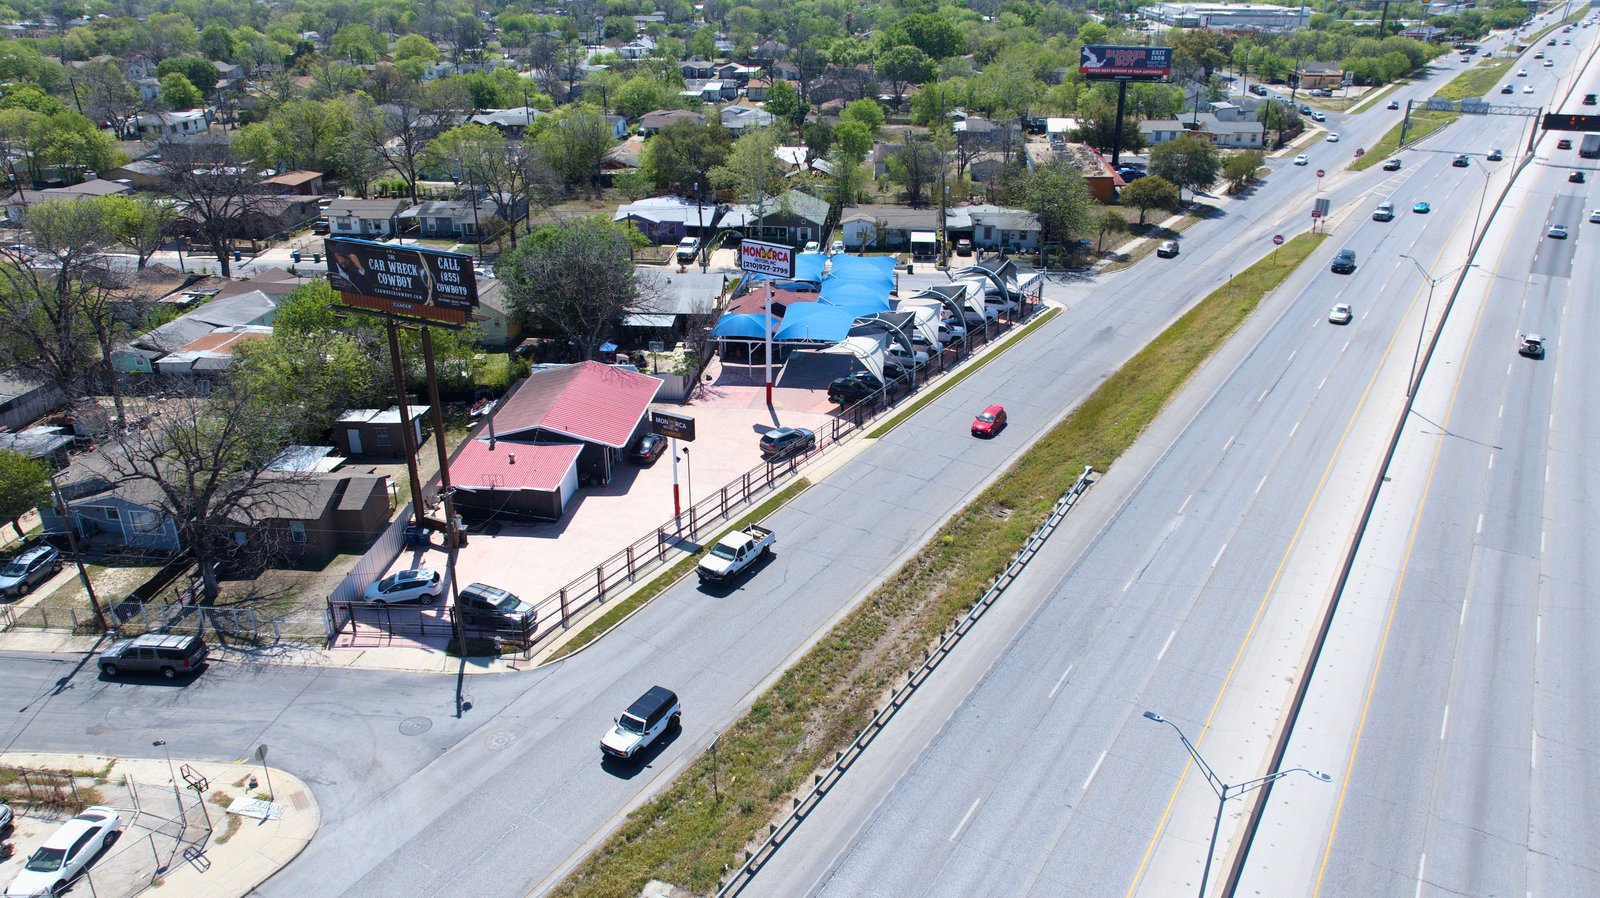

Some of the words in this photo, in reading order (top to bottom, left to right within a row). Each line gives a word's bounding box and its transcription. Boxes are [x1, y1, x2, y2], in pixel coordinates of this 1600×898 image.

[1105, 49, 1145, 58] BURGER
[1115, 57, 1136, 67] BOY
[368, 258, 386, 272] CAR
[387, 260, 418, 276] WRECK
[437, 256, 460, 271] CALL
[743, 260, 788, 273] (210)927-2799
[377, 272, 412, 288] COWBOY
[440, 271, 460, 284] (855)
[655, 417, 687, 429] MONRCA
